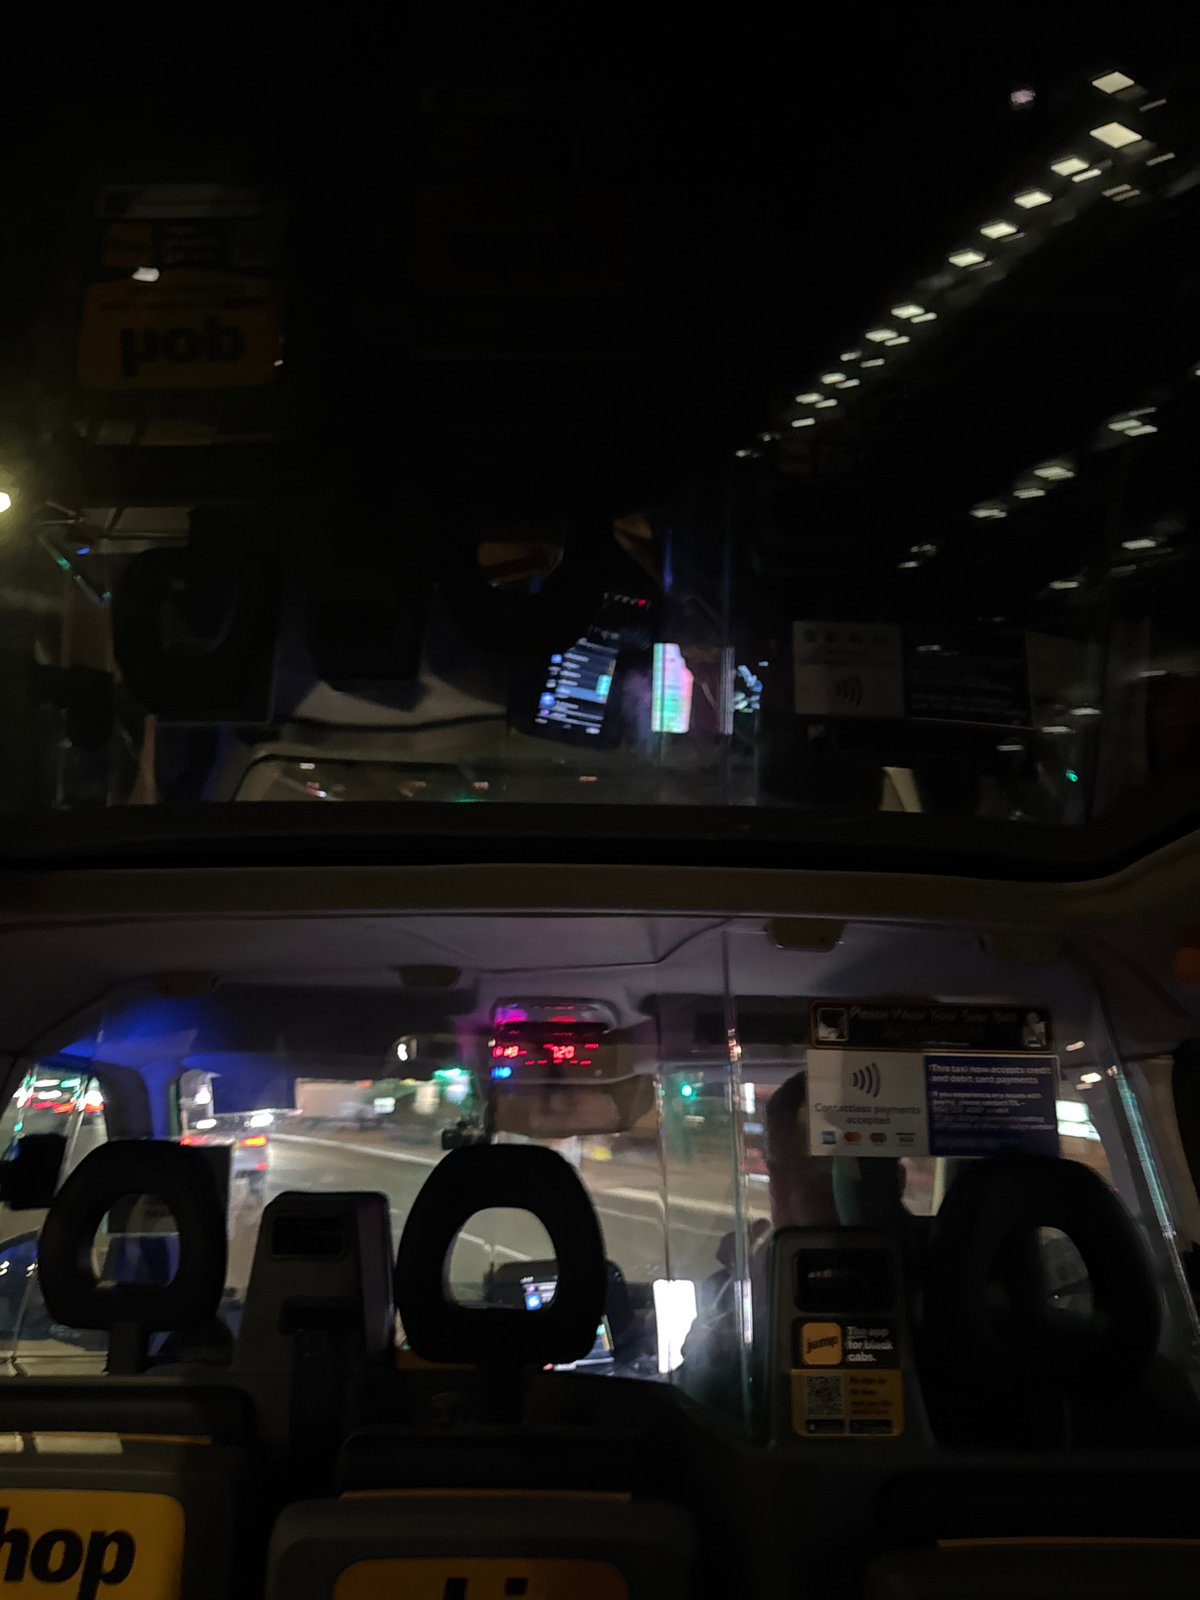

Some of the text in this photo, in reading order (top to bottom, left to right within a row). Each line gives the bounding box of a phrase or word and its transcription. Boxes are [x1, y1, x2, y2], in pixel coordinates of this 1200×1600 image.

[815, 1103, 872, 1113] Contactless
[874, 1105, 921, 1116] payments
[846, 1117, 891, 1125] accepted
[847, 1341, 894, 1350] for black
[0, 1507, 136, 1600] hop
